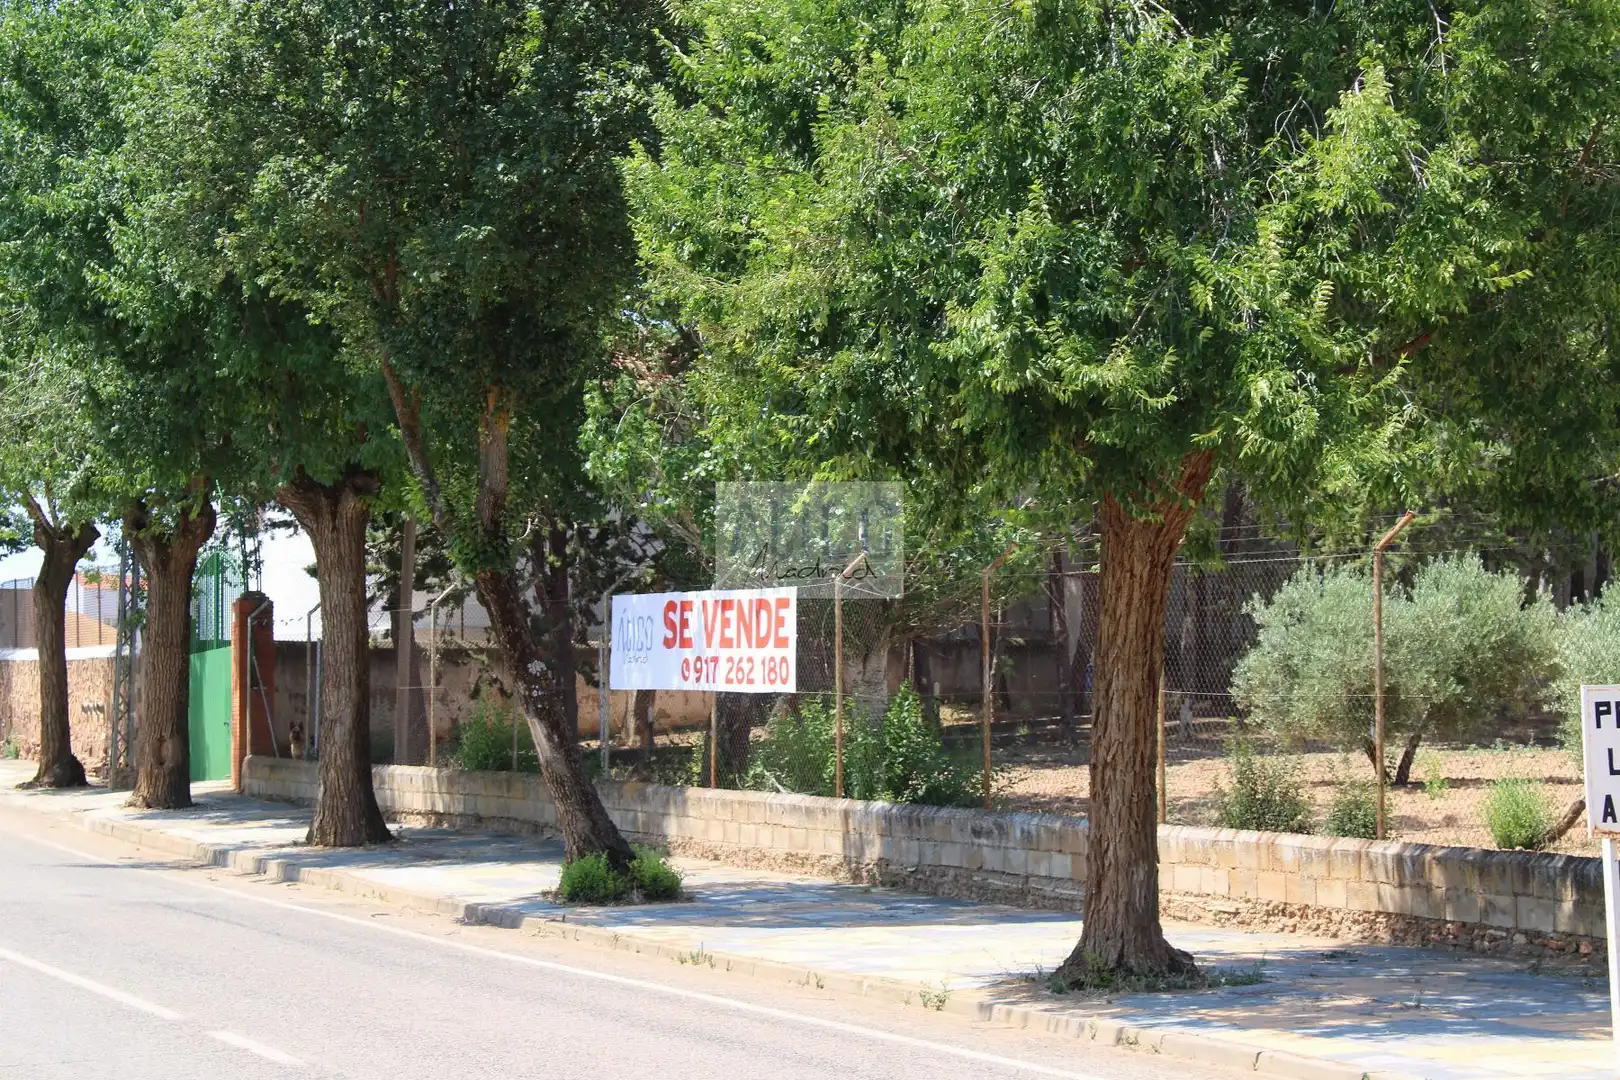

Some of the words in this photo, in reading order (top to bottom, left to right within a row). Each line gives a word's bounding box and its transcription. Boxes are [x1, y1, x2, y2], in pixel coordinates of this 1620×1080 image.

[663, 599, 694, 649] SE
[702, 597, 790, 649] VENDE
[694, 655, 719, 684] 917
[725, 656, 755, 685] 262
[761, 656, 790, 685] 180
